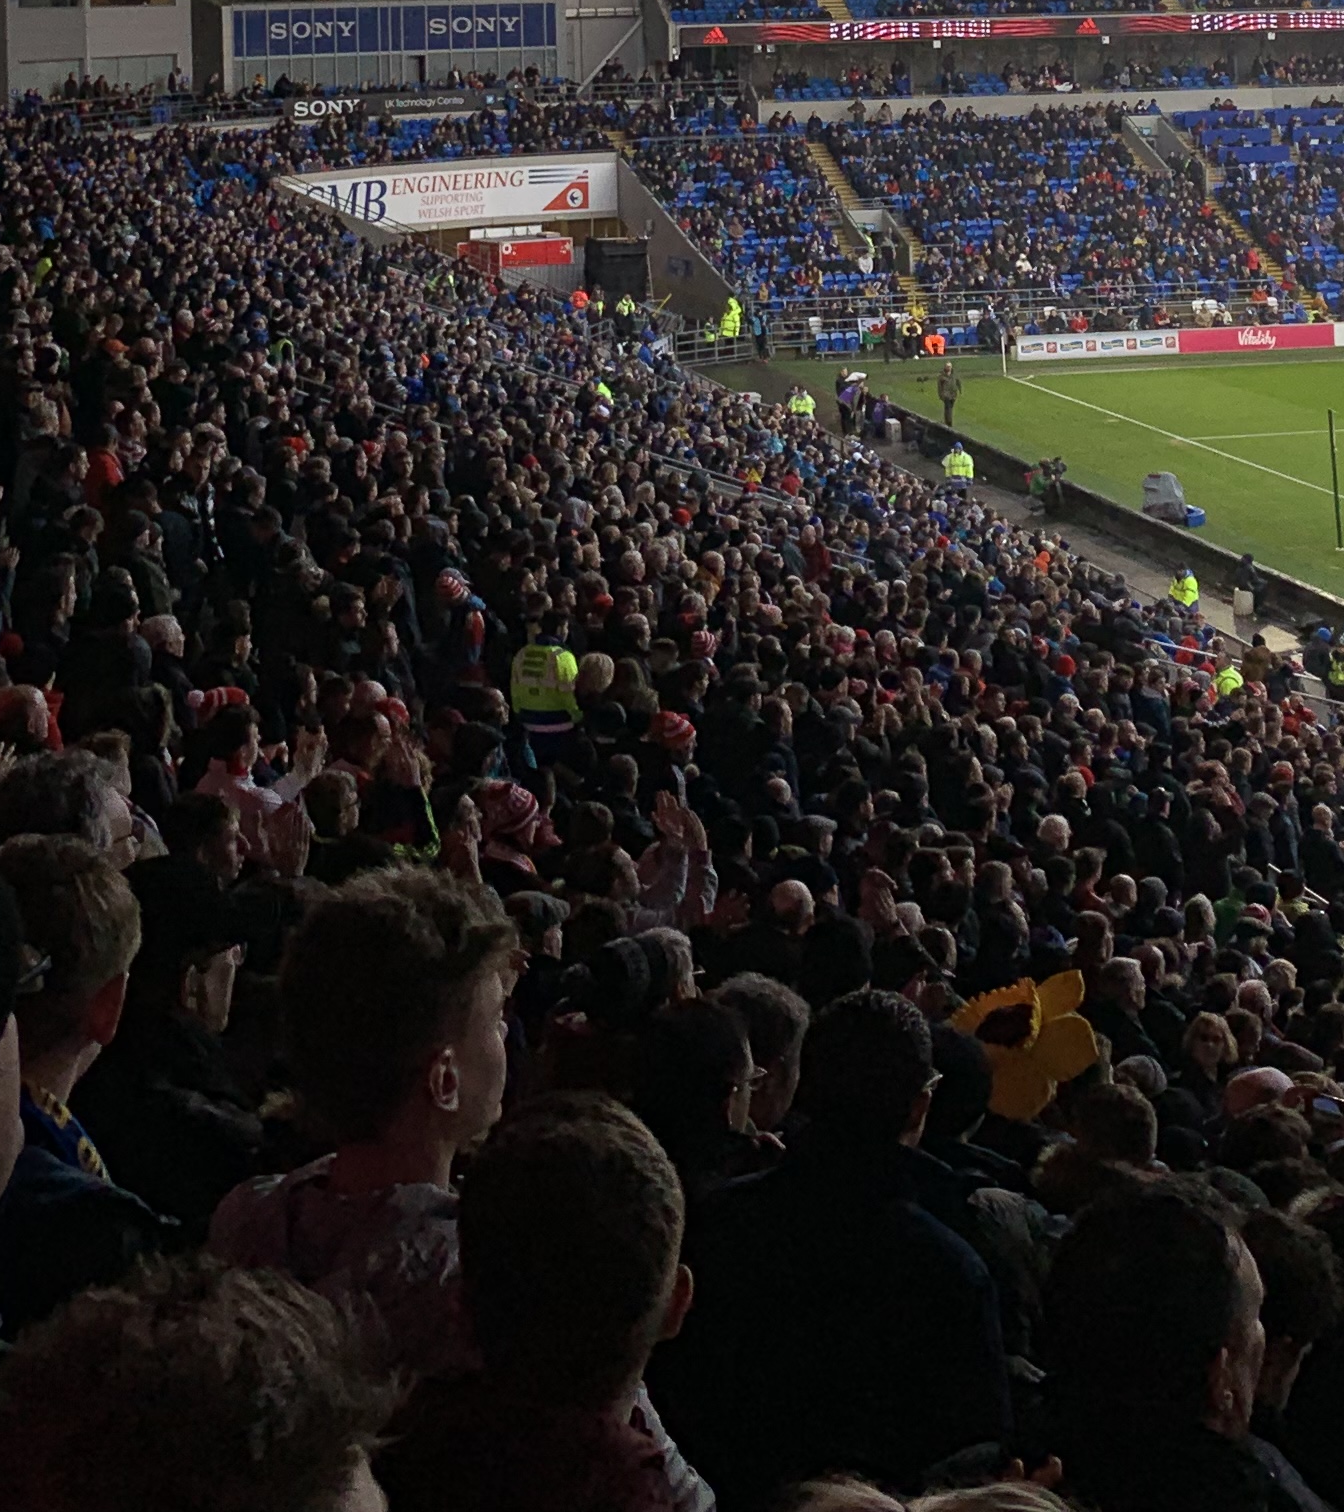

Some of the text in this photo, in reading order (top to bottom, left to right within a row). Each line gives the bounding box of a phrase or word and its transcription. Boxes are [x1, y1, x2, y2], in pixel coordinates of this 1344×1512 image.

[270, 21, 356, 39] SONY
[429, 16, 520, 35] SONY
[293, 99, 360, 118] SONY
[390, 170, 525, 196] ENGINEERING
[420, 192, 484, 207] SUPPORTING
[418, 204, 486, 219] WELSH SPORT
[1238, 327, 1277, 349] Vitality
